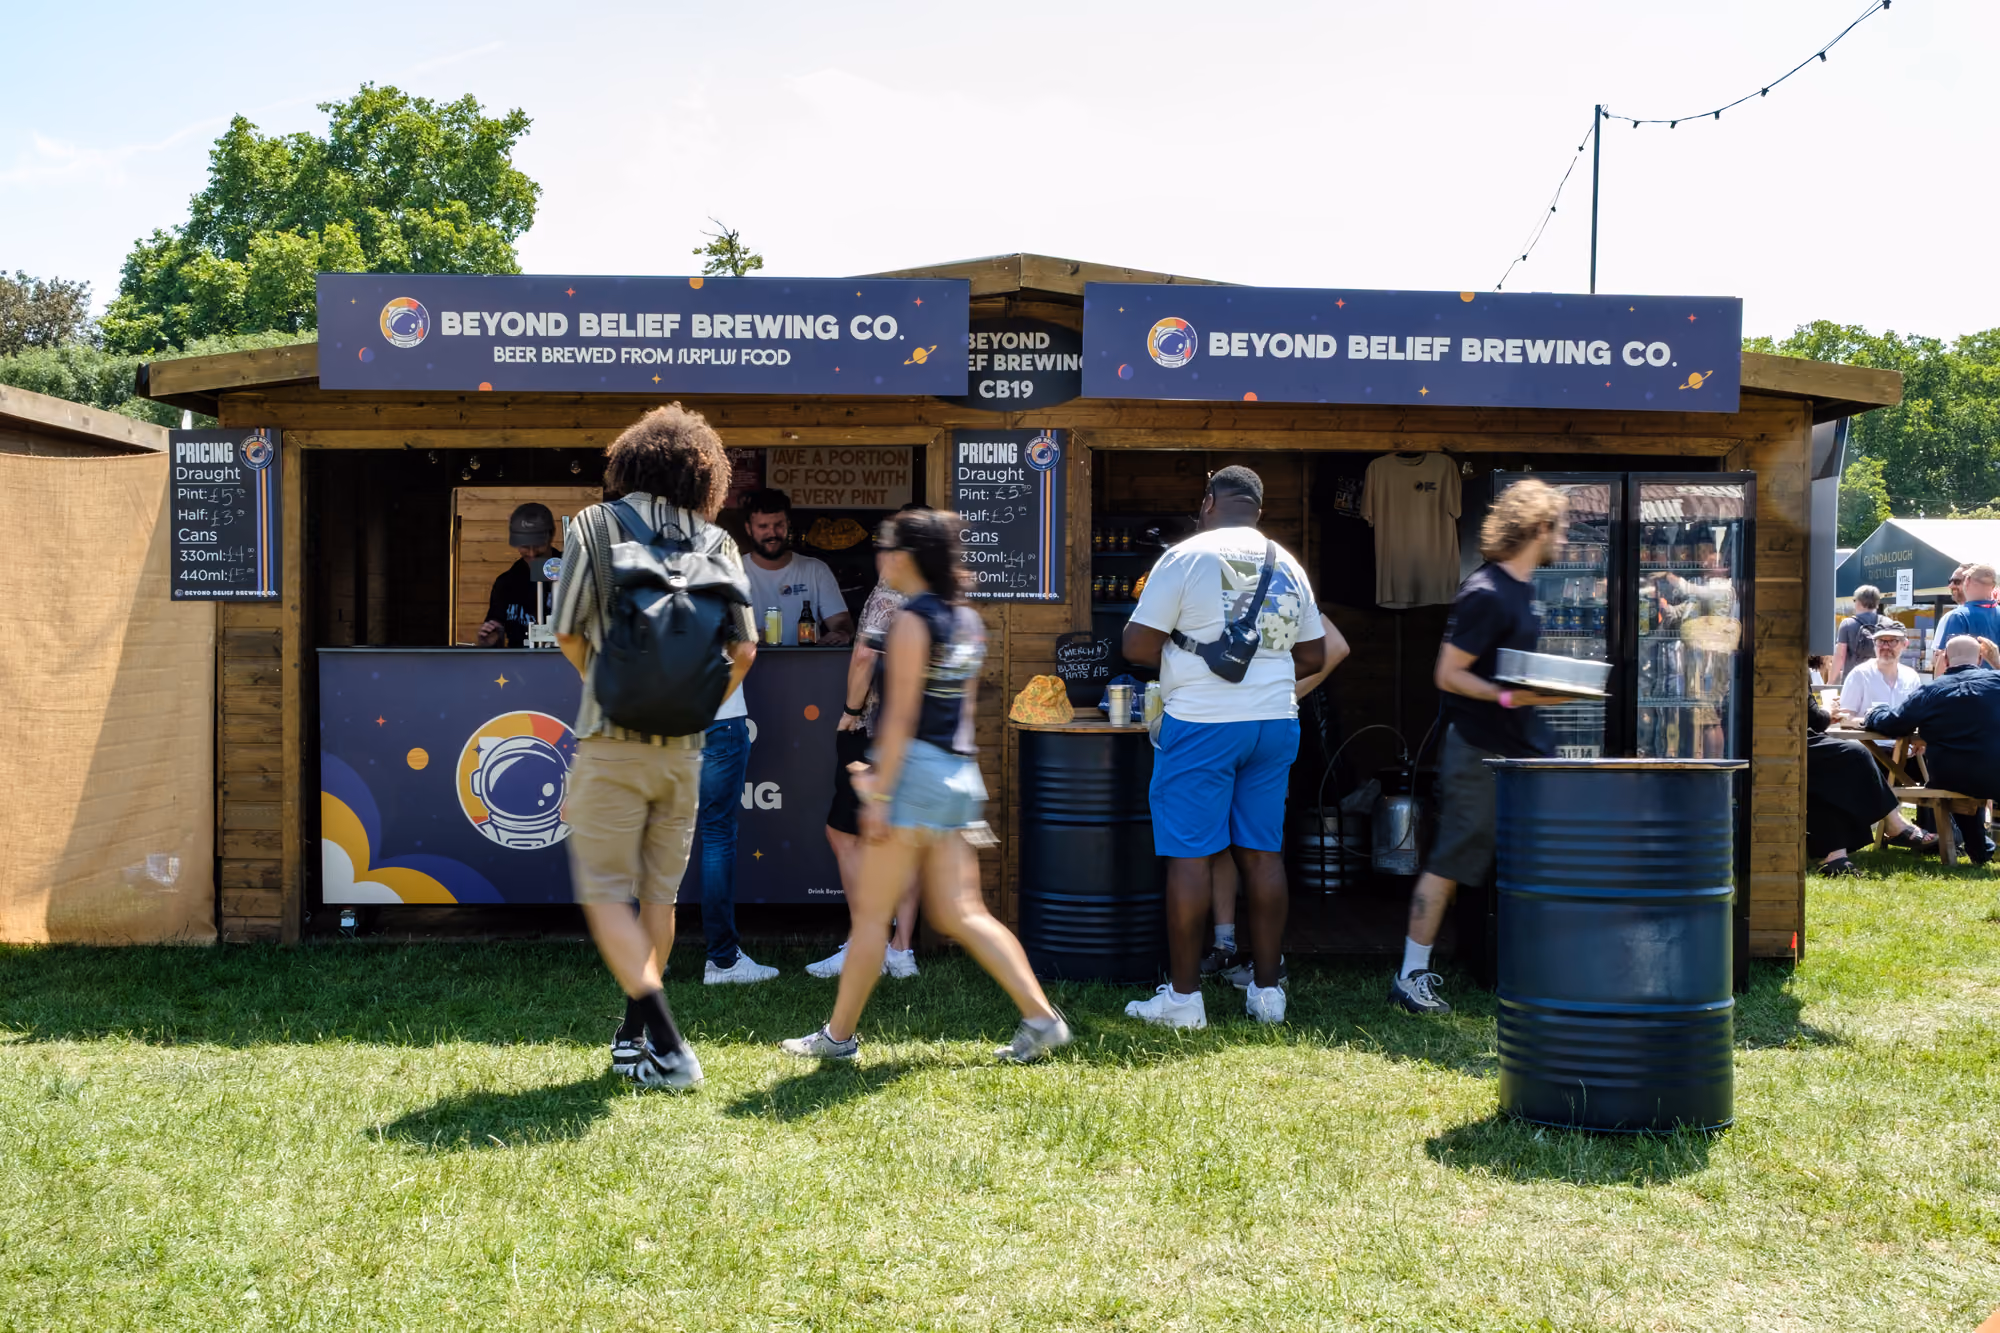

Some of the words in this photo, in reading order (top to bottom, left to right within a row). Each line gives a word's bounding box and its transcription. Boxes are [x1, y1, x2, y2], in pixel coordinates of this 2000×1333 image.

[441, 311, 569, 337] BEYOND
[580, 313, 681, 339] BELIEF
[692, 314, 840, 341] BREWING
[849, 315, 905, 341] CO.
[969, 332, 1050, 350] BEYOND
[1208, 331, 1338, 359] BEYOND
[1348, 335, 1451, 362] BELIEF
[1461, 337, 1612, 366] BREWING
[1622, 340, 1678, 367] CO.
[493, 346, 538, 363] BEER
[541, 347, 617, 364] BREWED
[620, 348, 674, 365] FROM
[677, 348, 738, 365] SURPLUS
[741, 349, 791, 366] FOOD
[993, 353, 1083, 371] BREWIN
[978, 379, 1034, 399] CB19
[176, 442, 234, 464] PRICING
[812, 449, 824, 466] A
[828, 450, 909, 467] PORTION
[958, 442, 1018, 465] PRICING
[176, 467, 241, 483] Draught
[773, 468, 799, 485] OF
[804, 468, 856, 486] FOOD
[862, 470, 908, 487] WITH
[958, 467, 1025, 483] Draught
[178, 488, 208, 500] Pint:
[791, 488, 846, 505] EVERY
[851, 488, 888, 505] PINT
[959, 488, 989, 500] Pint:
[178, 508, 208, 521] Half:
[959, 509, 990, 522] Half:
[178, 528, 218, 541] Cans
[959, 528, 999, 544] Cans
[179, 549, 226, 562] 330ml:
[959, 550, 1007, 563] 330ml:
[1863, 549, 1913, 566] GLENDALOUGH
[180, 569, 228, 581] 440ml:
[1016, 592, 1046, 600] BREWING
[1093, 666, 1109, 677] £15
[807, 887, 825, 895] Drink
[826, 888, 844, 896] Beyon
